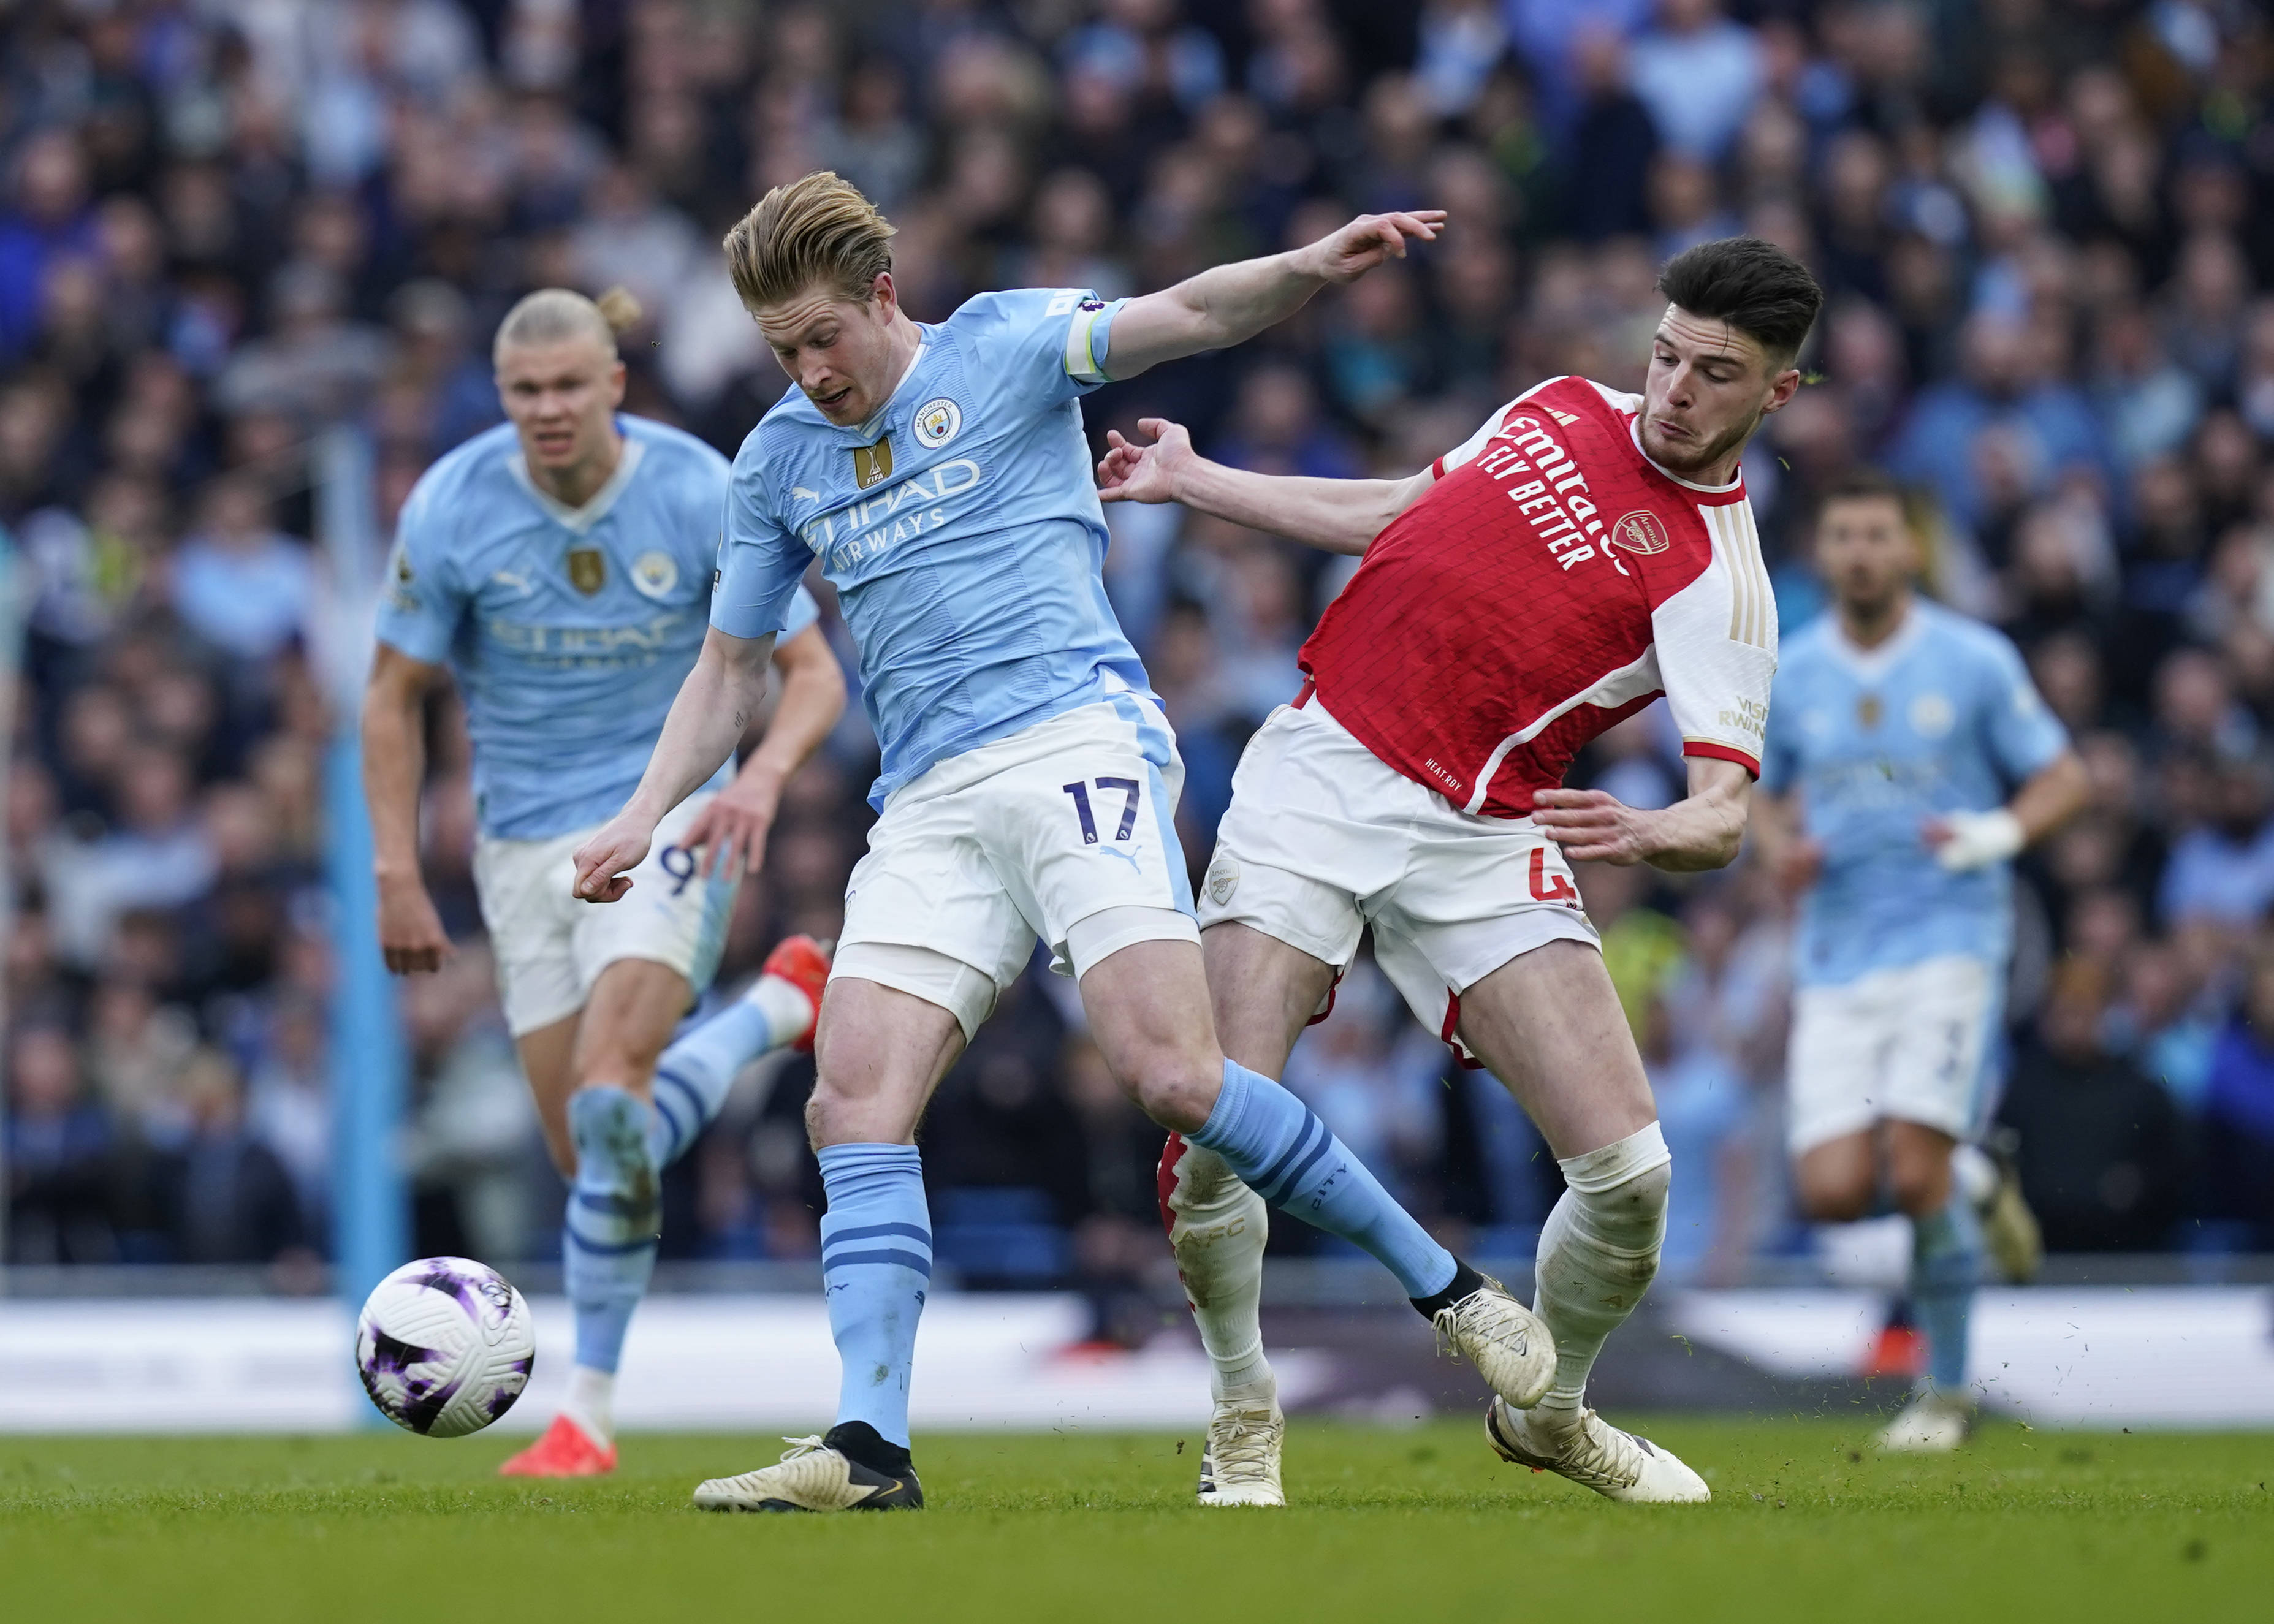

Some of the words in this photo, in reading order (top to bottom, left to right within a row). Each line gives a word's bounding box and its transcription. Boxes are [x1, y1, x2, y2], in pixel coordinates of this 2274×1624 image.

[917, 401, 953, 428] MANCHESTER
[938, 435, 951, 445] CITY
[867, 472, 884, 485] FIFA
[1494, 416, 1630, 577] Emira
[1476, 445, 1531, 480] FLY
[1507, 479, 1595, 571] BETTER
[831, 508, 945, 573] AIRWAYS
[1639, 516, 1662, 546] Arsenal
[1735, 695, 1769, 721] VISI
[1063, 776, 1140, 845] 17
[660, 844, 694, 897] 9
[1312, 1163, 1347, 1211] CITY
[1177, 1216, 1245, 1250] AFC
